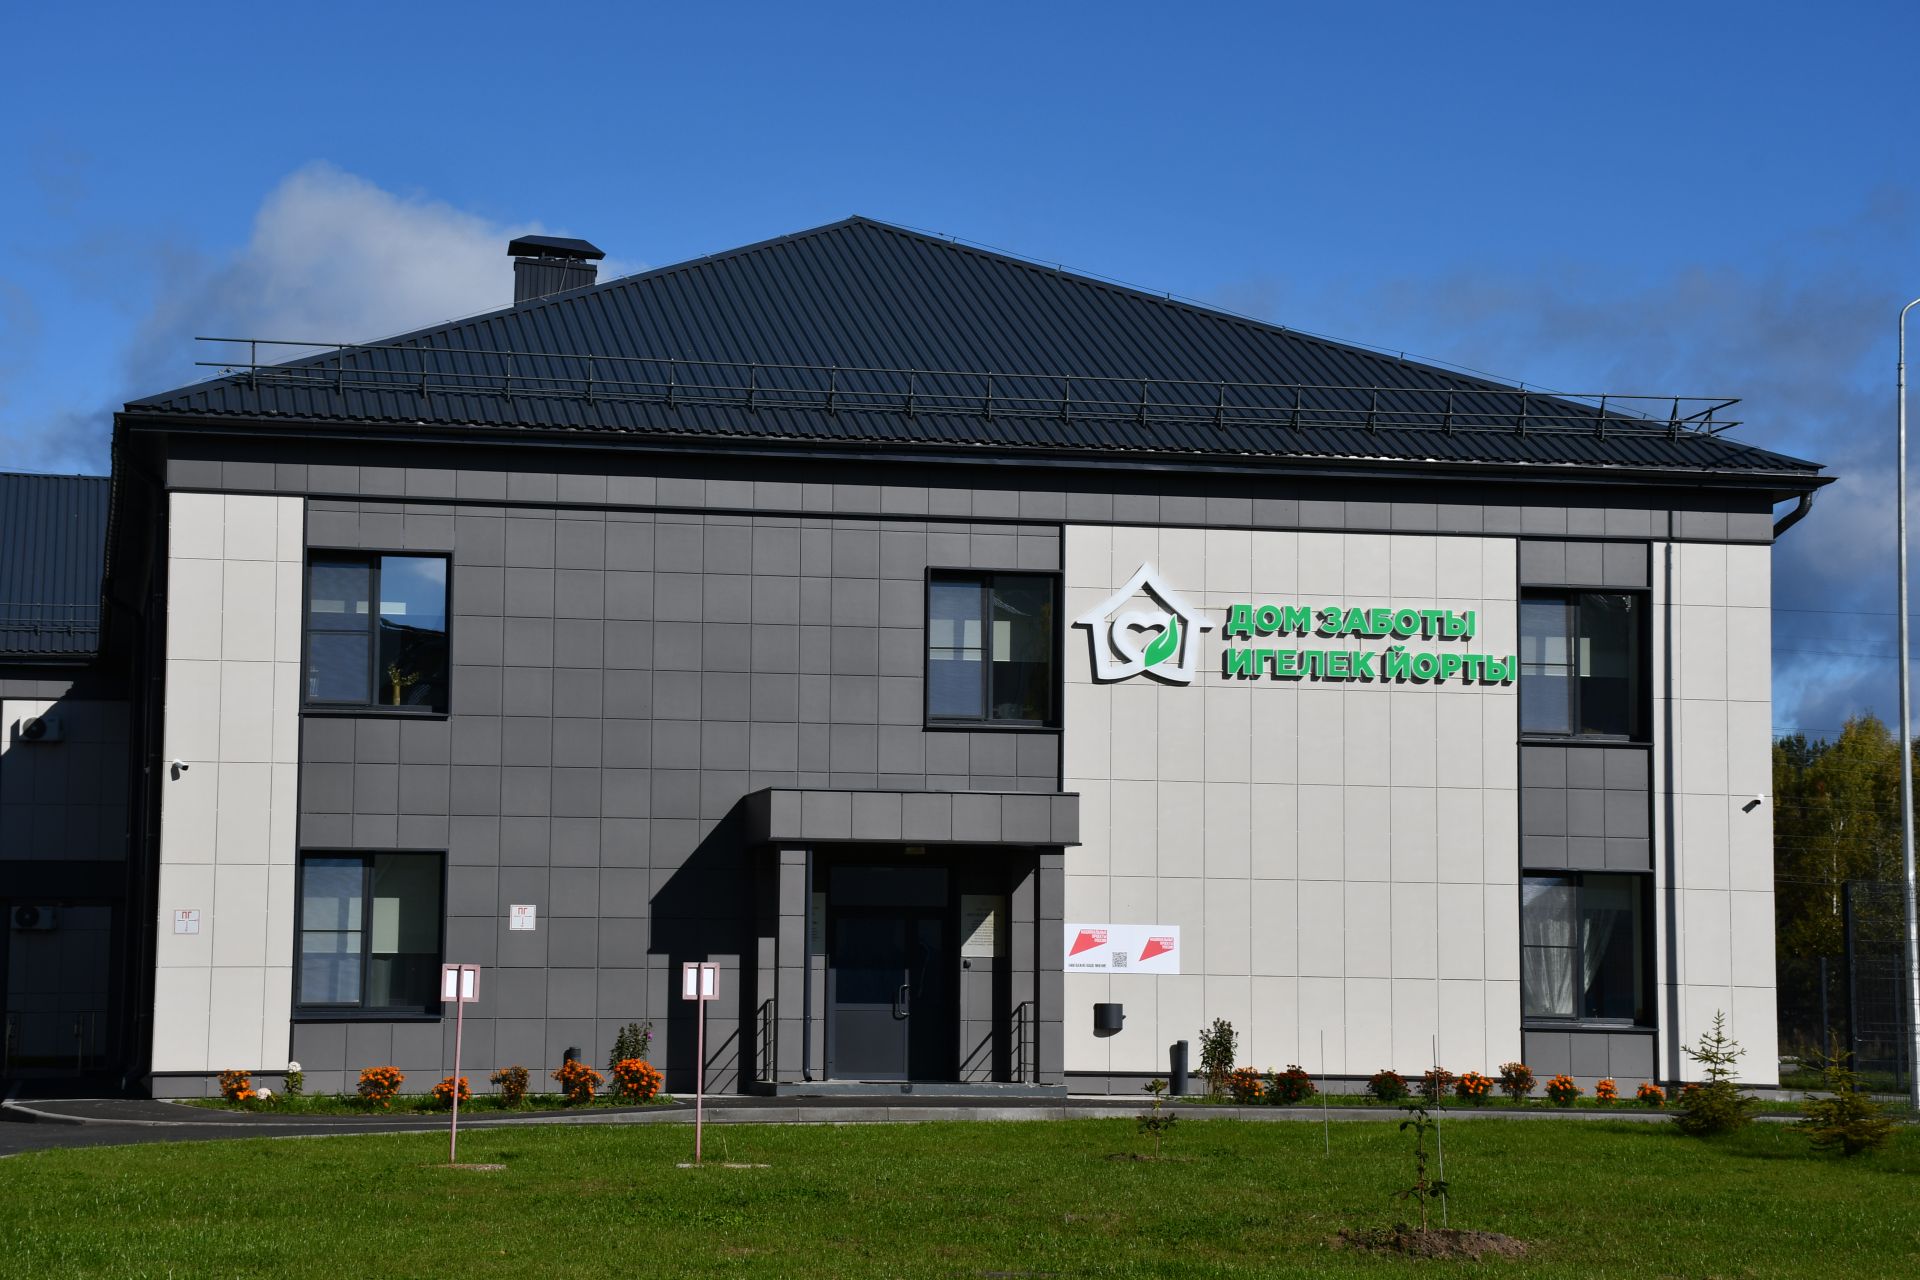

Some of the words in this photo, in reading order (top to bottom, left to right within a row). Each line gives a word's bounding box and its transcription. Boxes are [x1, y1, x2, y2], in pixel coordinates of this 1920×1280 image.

[1227, 604, 1312, 636] ДОМ
[1321, 606, 1476, 637] ЗАБОТЫ
[1227, 648, 1377, 679] ИГЕЛЕК
[1385, 645, 1516, 681] ЙОРТЫ
[181, 911, 192, 919] ПГ
